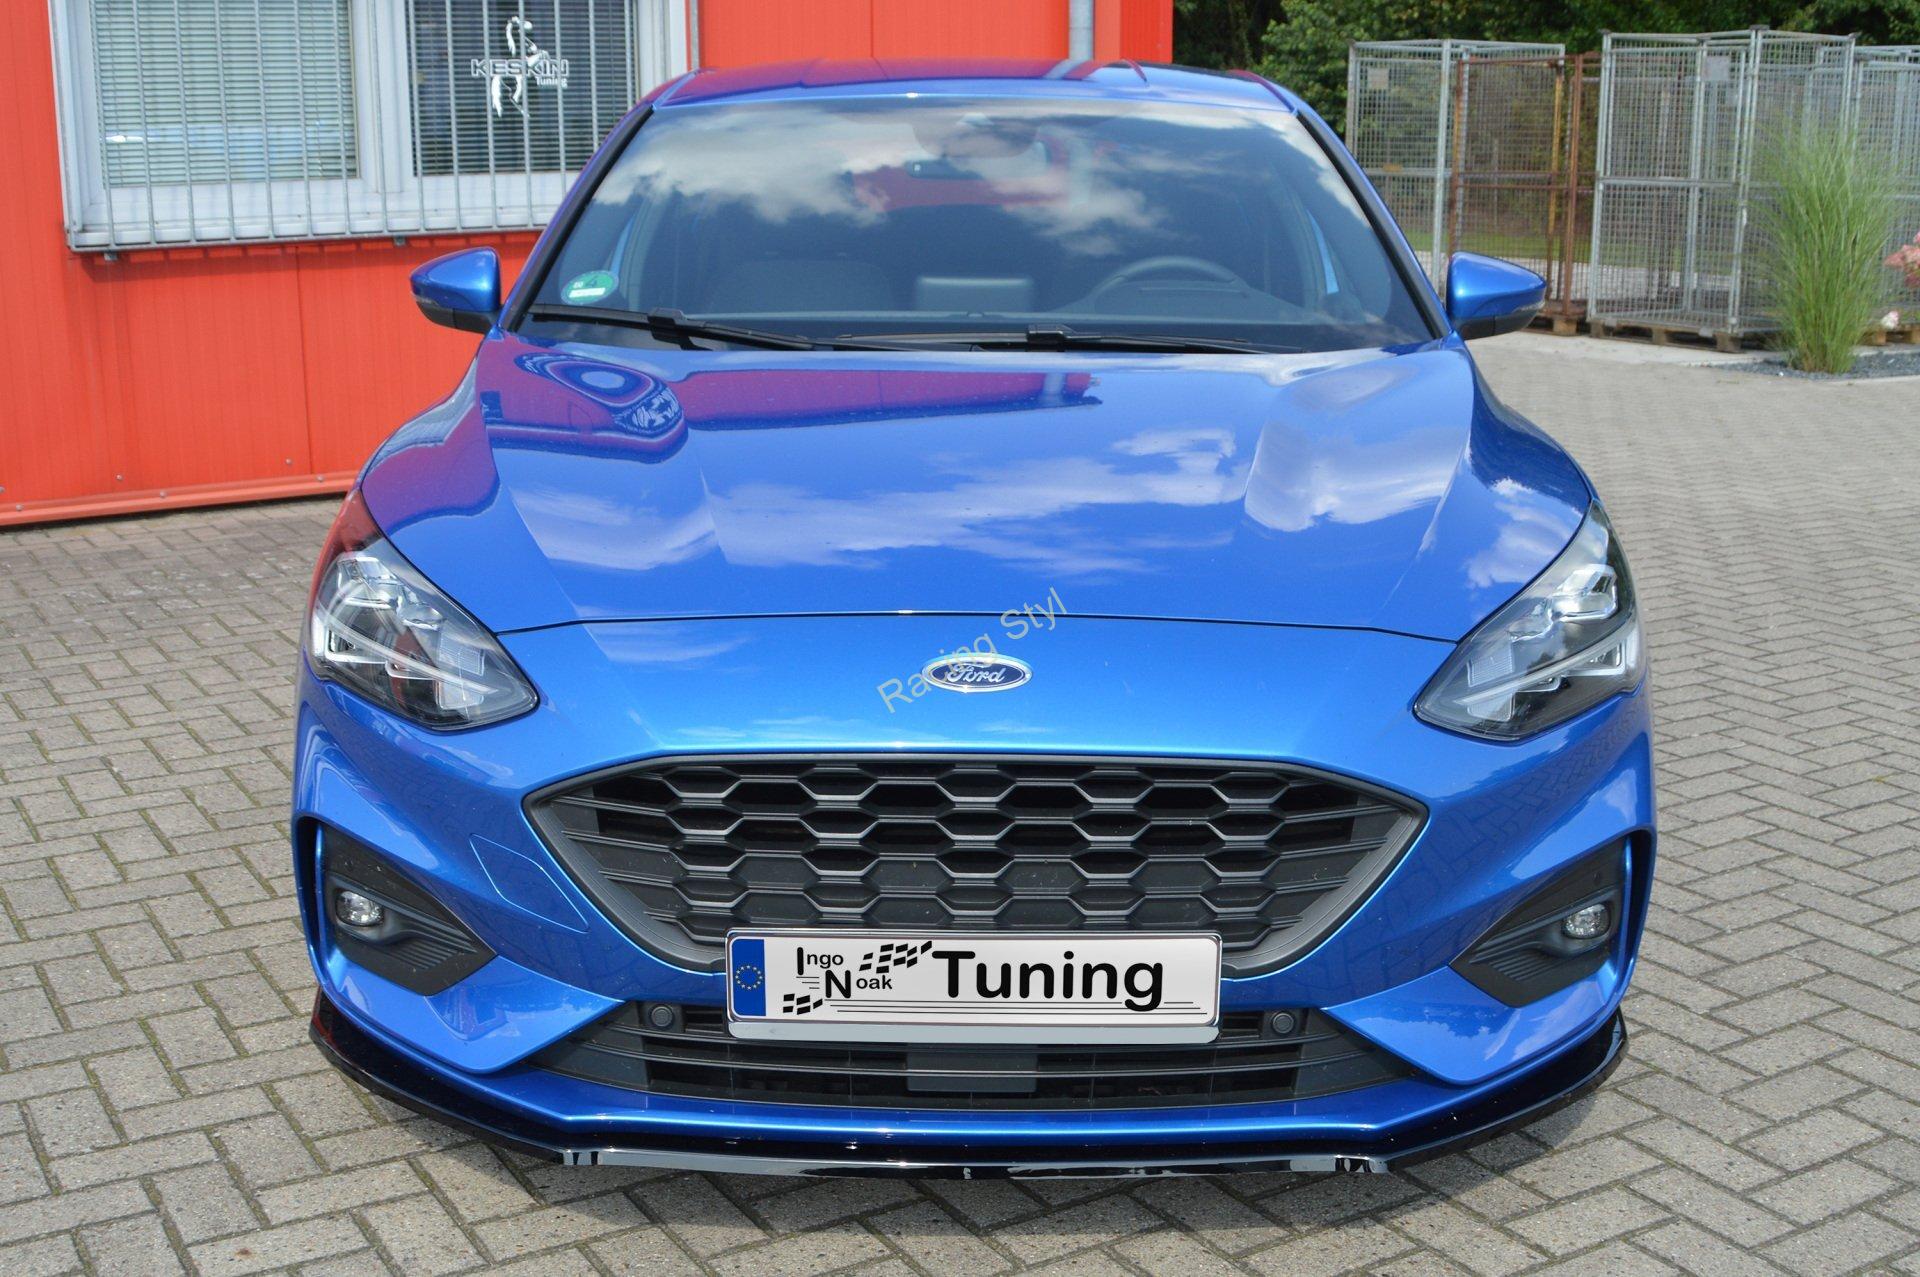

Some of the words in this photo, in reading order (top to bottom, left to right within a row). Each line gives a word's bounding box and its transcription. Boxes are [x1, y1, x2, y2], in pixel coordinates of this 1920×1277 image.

[470, 59, 570, 77] KESKIN
[946, 662, 1005, 683] Ford
[796, 947, 844, 976] Ingo
[825, 970, 893, 999] Noak
[931, 950, 1164, 1012] Tuning
